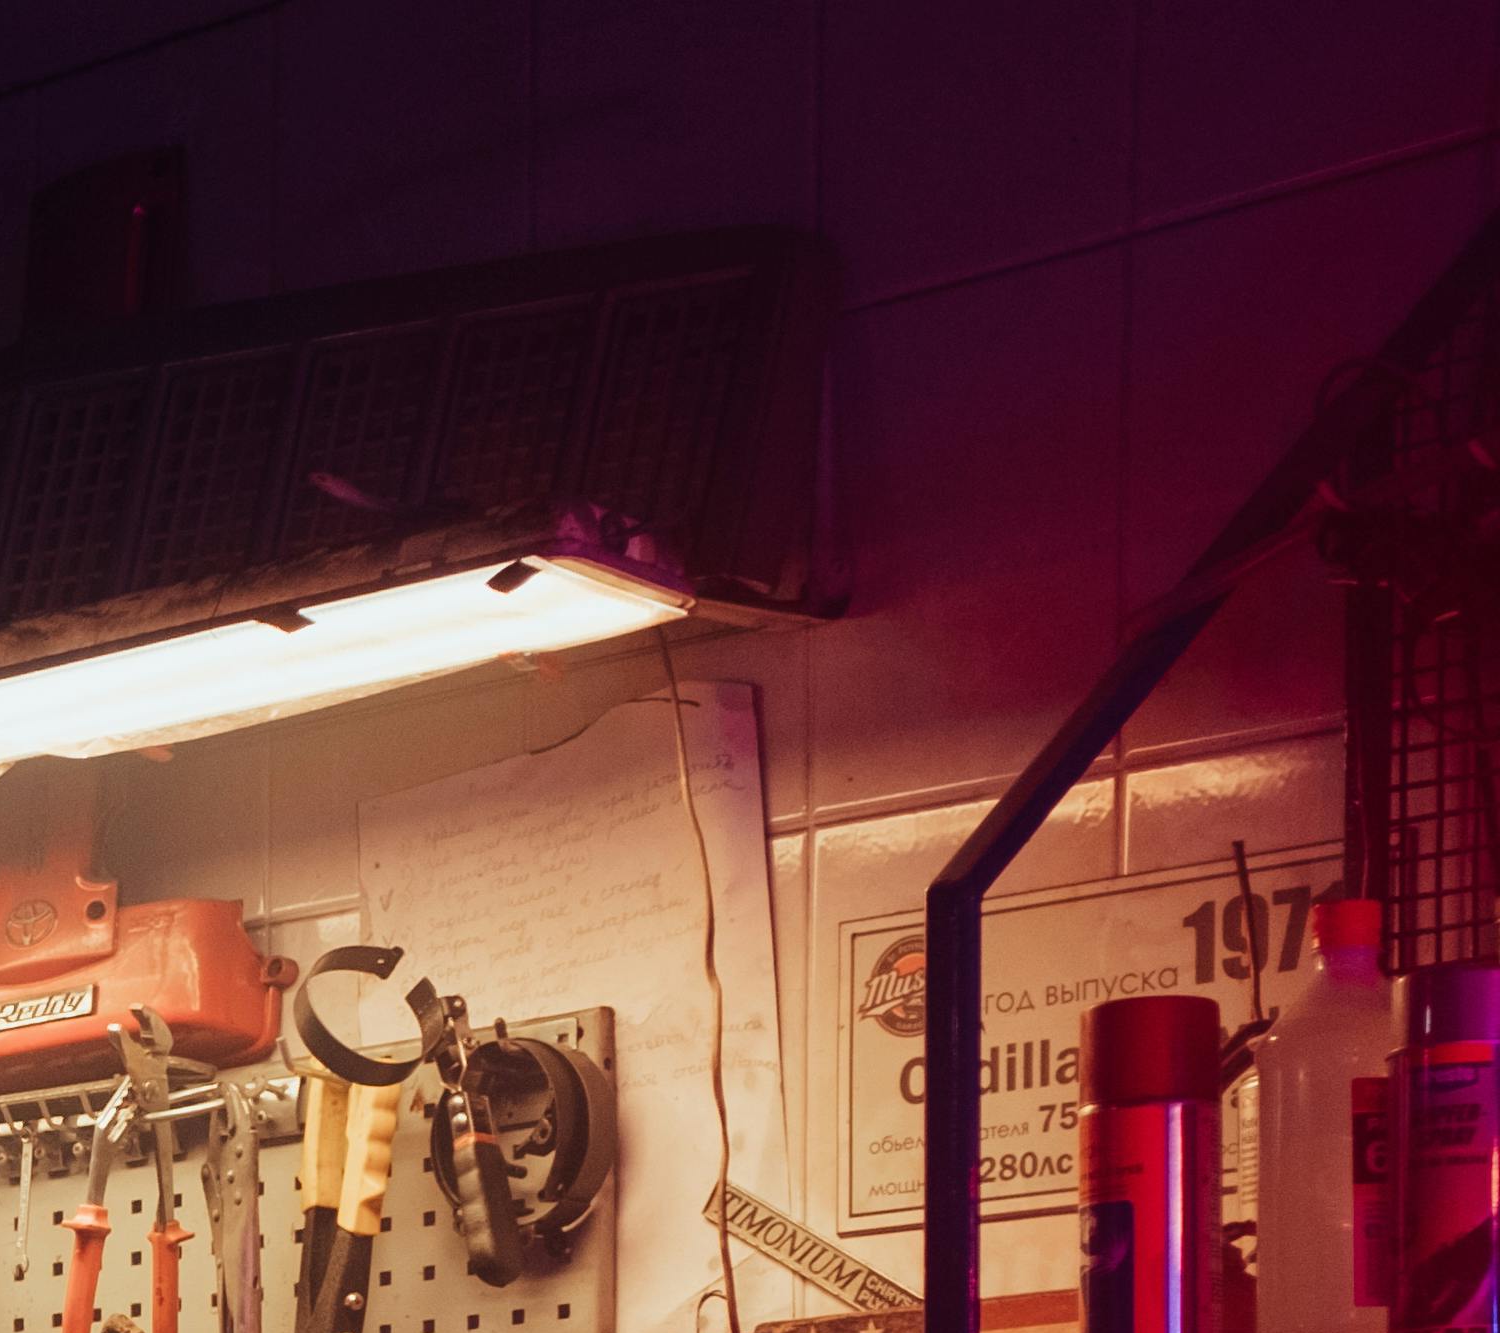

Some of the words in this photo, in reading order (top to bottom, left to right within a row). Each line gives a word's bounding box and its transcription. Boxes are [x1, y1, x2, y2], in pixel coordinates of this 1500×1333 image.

[1182, 880, 1343, 985] 197
[858, 966, 925, 1018] Mus
[1045, 966, 1179, 1007] выпуска
[900, 1038, 1080, 1105] Cdilla
[1038, 1101, 1079, 1133] 75
[868, 1180, 925, 1199] мощн
[726, 1191, 863, 1291] TIMONIUM
